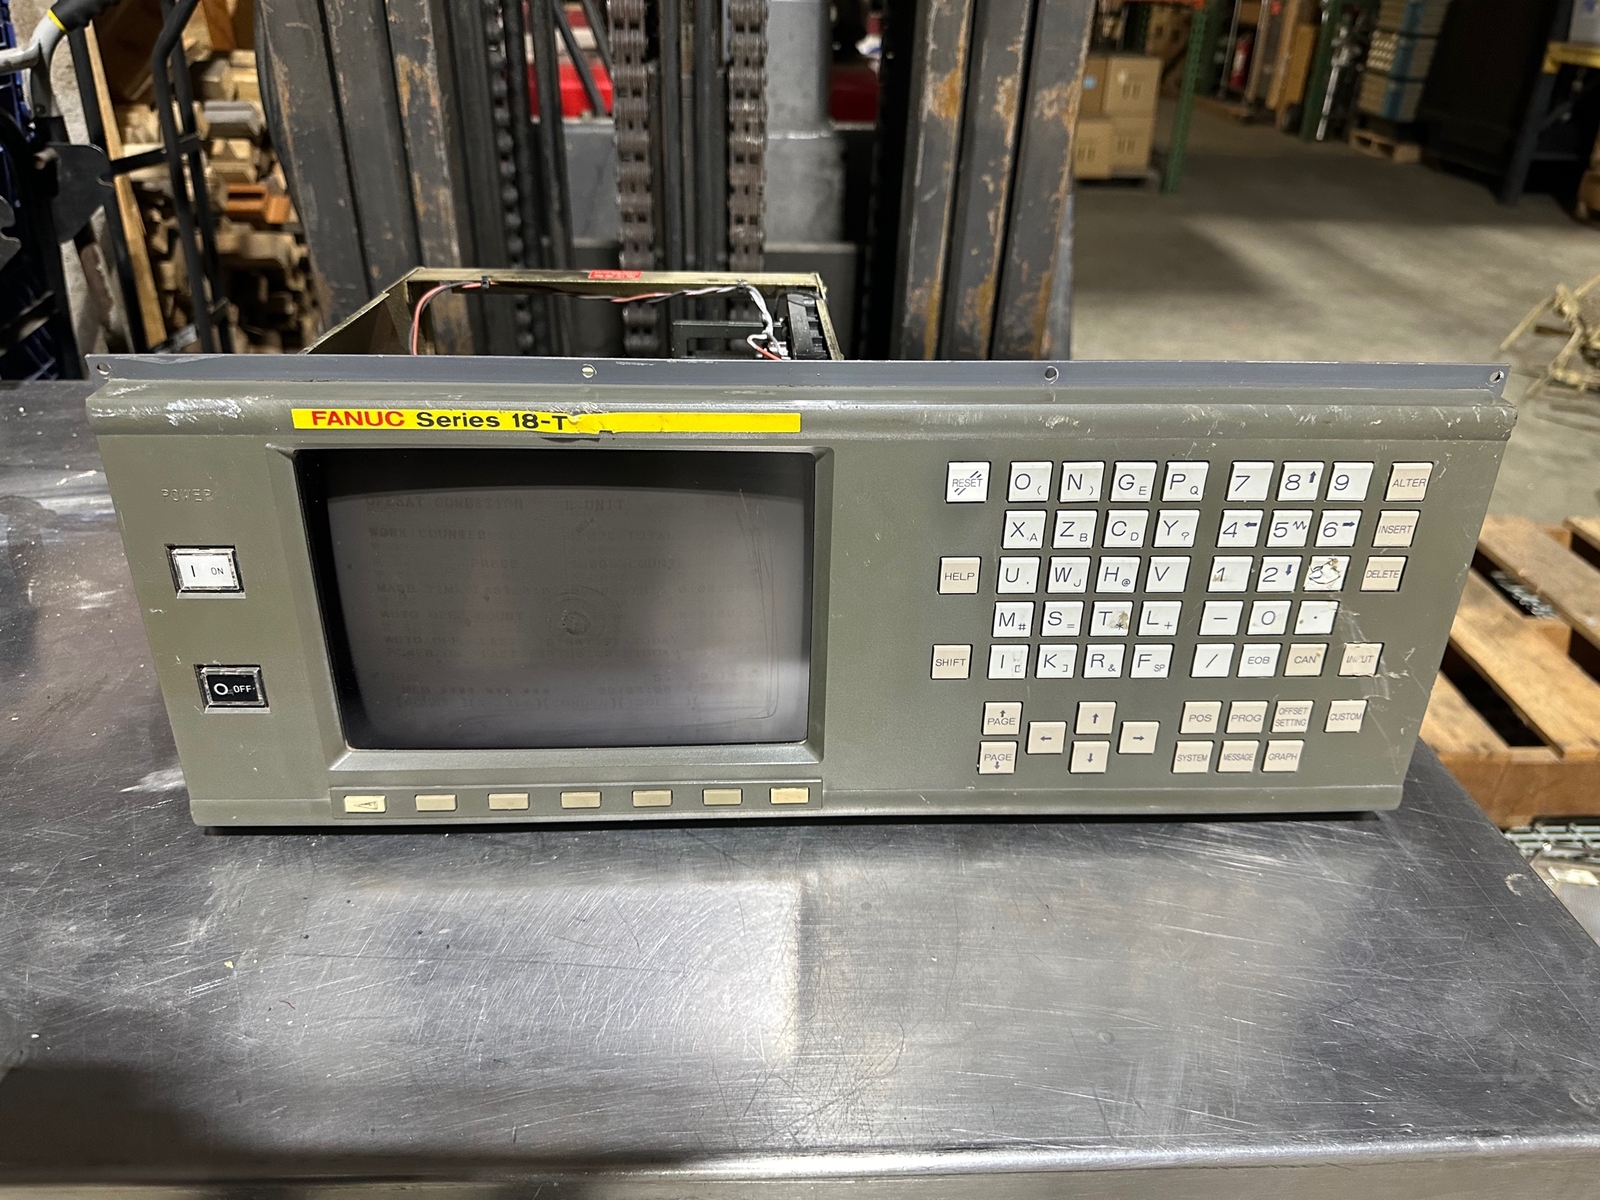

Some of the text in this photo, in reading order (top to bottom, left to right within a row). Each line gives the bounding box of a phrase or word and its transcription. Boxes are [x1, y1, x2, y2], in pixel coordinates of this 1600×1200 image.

[311, 410, 568, 430] FANUC Series 18-T
[952, 478, 983, 488] RESET
[1067, 473, 1083, 491] N
[1118, 473, 1135, 491] G
[1170, 473, 1186, 490] P
[1235, 475, 1250, 492] 7
[1285, 474, 1300, 491] 8
[1334, 474, 1349, 491] 9
[1392, 478, 1426, 488] ALTER
[161, 488, 213, 502] POWER
[1010, 521, 1026, 538] X
[1060, 521, 1075, 537] Z
[1111, 520, 1127, 537] C
[1163, 520, 1179, 536] Y
[1223, 522, 1237, 538] 4
[1273, 522, 1288, 538] 5
[1323, 522, 1338, 538] 6
[1378, 524, 1413, 534] INSERT
[211, 567, 224, 576] ON
[944, 572, 975, 581] HELP
[1005, 568, 1020, 583] U
[1055, 567, 1072, 583] W
[1104, 567, 1119, 582] H
[1154, 566, 1170, 582] V
[1216, 567, 1226, 582] 1
[1262, 567, 1278, 583] 2
[1366, 570, 1400, 579] DELETE
[999, 612, 1015, 627] M
[1047, 611, 1063, 626] S
[1099, 611, 1113, 626] T
[1146, 611, 1159, 625] L
[935, 658, 966, 667] SHIFT
[1043, 654, 1057, 668] K
[1090, 654, 1105, 668] R
[1137, 654, 1152, 668] F
[1247, 656, 1270, 664] EOB
[1294, 655, 1317, 664] CAN
[233, 685, 252, 694] OFF
[1278, 707, 1308, 715] OFFSET
[1329, 713, 1362, 721] CUSTOM
[987, 717, 1016, 726] PAGE
[1189, 714, 1212, 723] POS
[1231, 714, 1262, 723] PROG
[1275, 718, 1307, 727] SETTING
[984, 753, 1012, 762] PAGE
[1177, 753, 1208, 762] SYSTEM
[1223, 753, 1254, 762] MESSAGE
[1268, 753, 1298, 761] GRAPH
